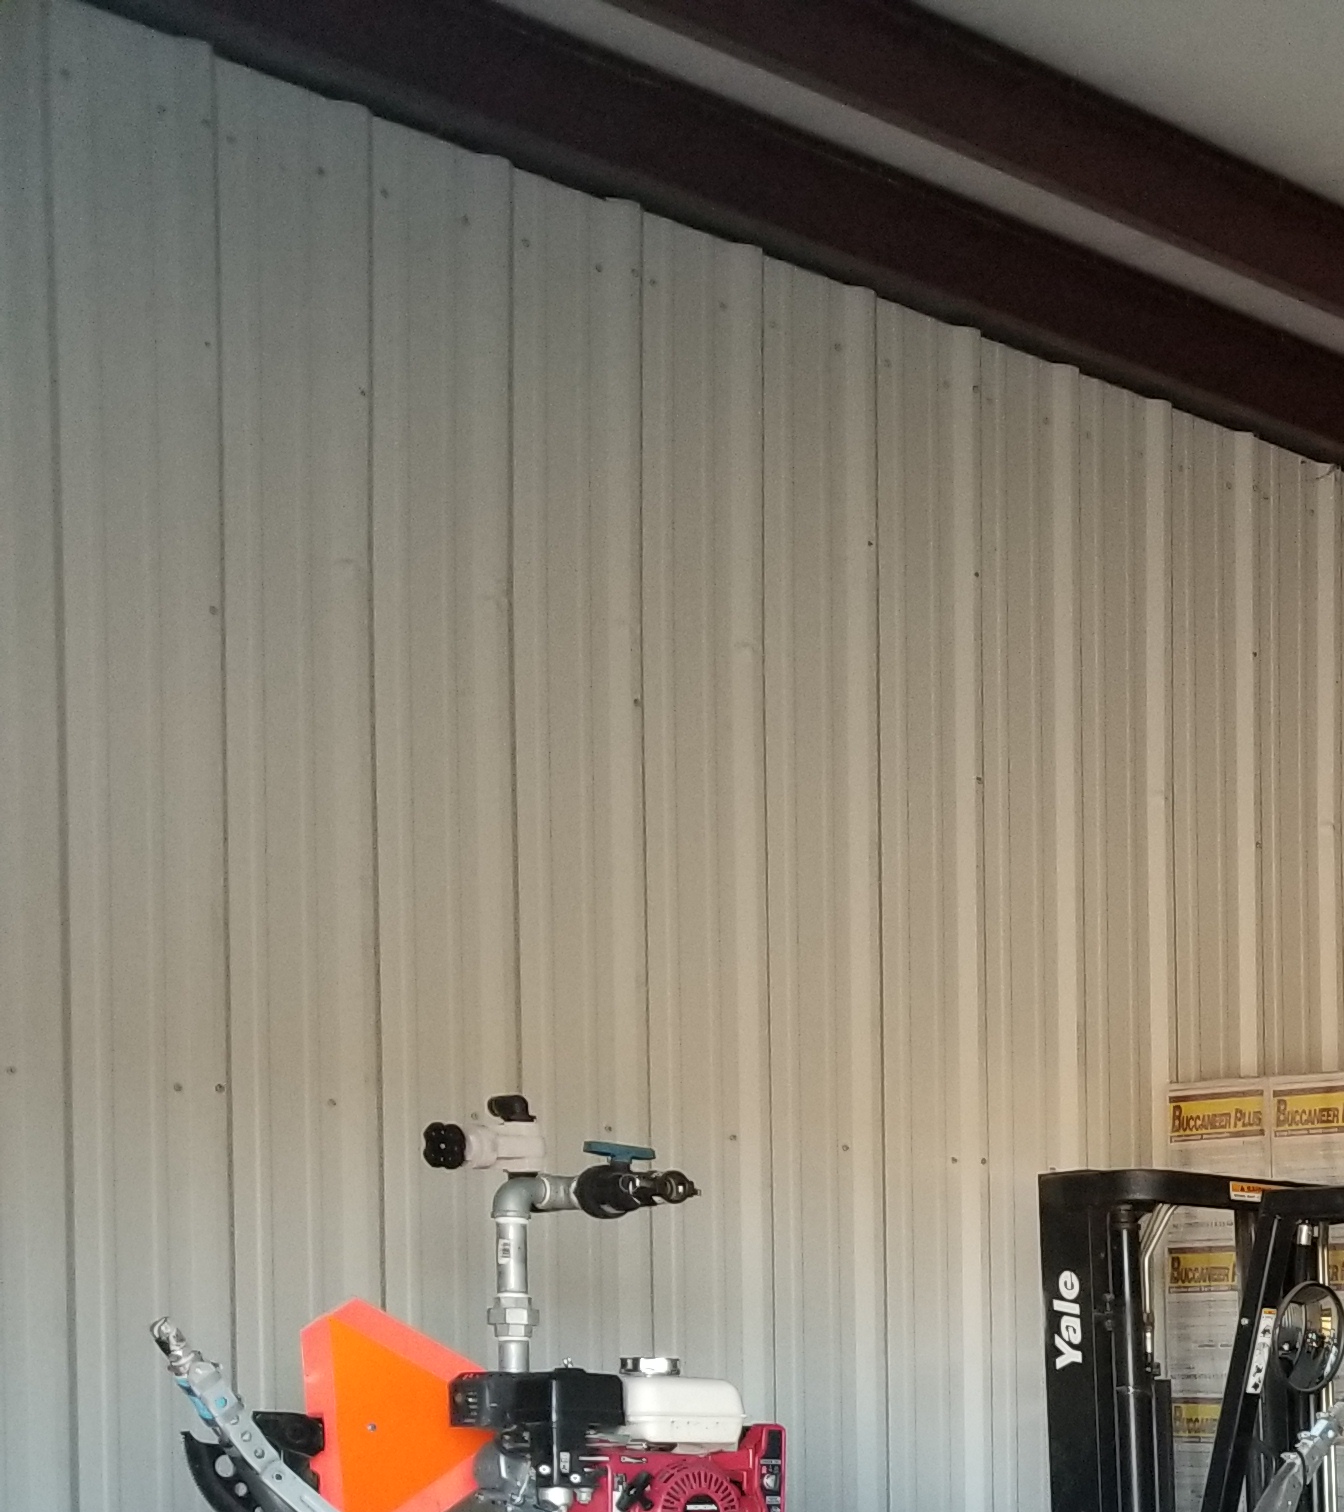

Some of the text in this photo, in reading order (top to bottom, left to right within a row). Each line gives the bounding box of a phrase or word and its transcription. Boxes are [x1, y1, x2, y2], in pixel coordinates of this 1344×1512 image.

[1171, 1104, 1262, 1133] BUCCANEER PLUS
[1276, 1099, 1339, 1129] BUCCANEER
[1170, 1256, 1230, 1286] BUCCANEER
[1053, 1270, 1082, 1371] Yale
